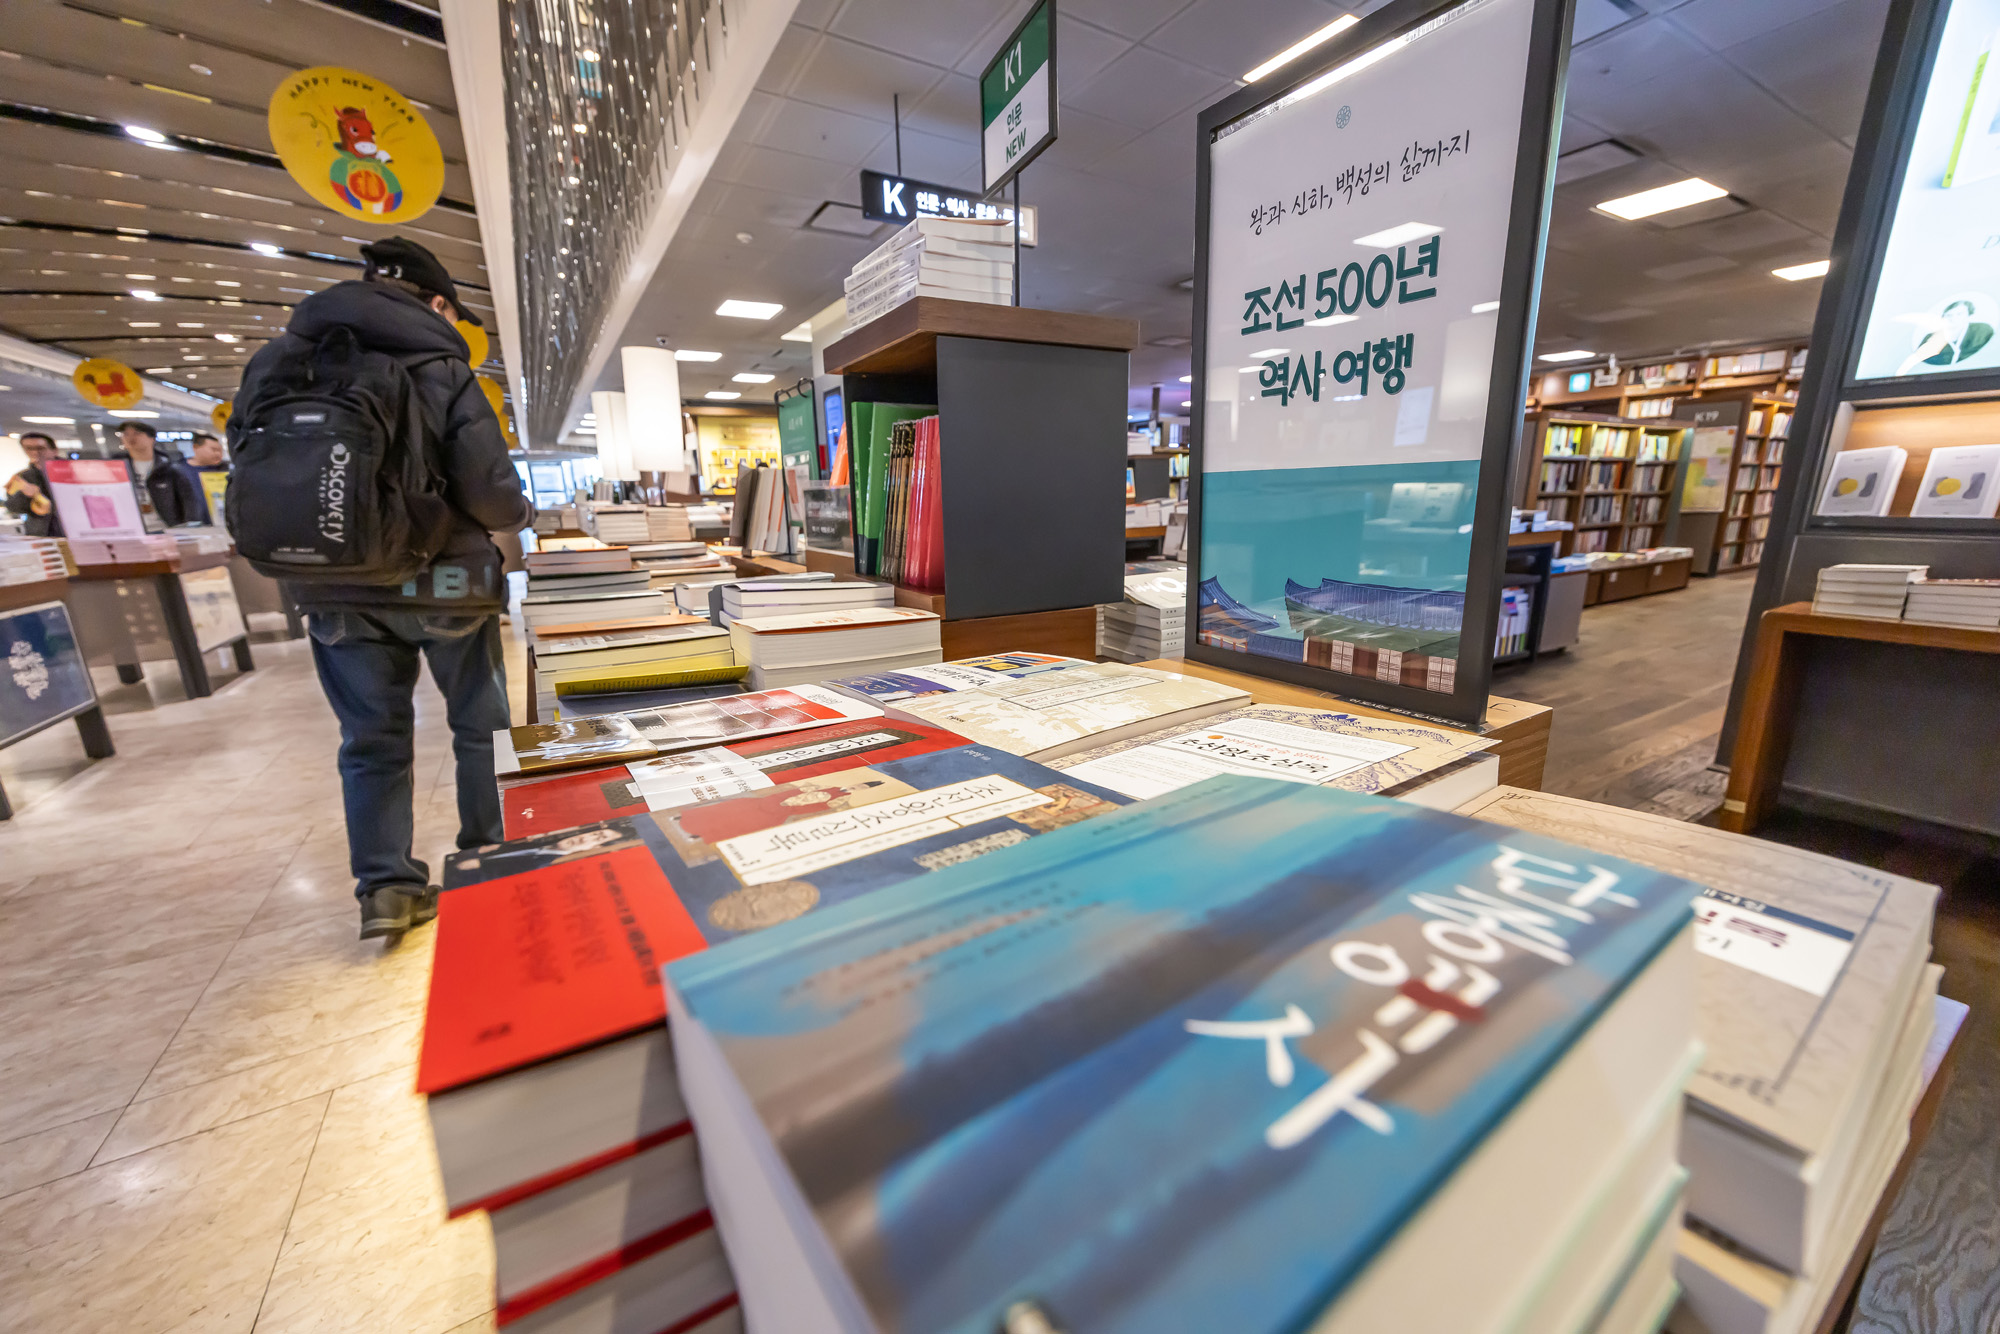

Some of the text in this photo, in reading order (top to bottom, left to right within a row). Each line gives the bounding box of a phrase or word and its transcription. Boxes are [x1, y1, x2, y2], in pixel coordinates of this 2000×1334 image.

[289, 77, 330, 99] HAPPY
[342, 77, 374, 92] NEW
[1004, 41, 1022, 92] K1
[1006, 101, 1023, 135] 인문
[1006, 127, 1027, 163] NEW
[882, 179, 907, 217] K
[1249, 129, 1471, 236] 왕과 신하, 백성의 삶까지
[1240, 235, 1441, 336] 조선 500년
[1258, 333, 1415, 407] 역사 여행
[322, 448, 351, 544] DISCOVERY
[1172, 737, 1329, 774] 조선왕조실록
[764, 783, 1004, 852] 조선왕조실록
[1184, 844, 1640, 1151] 단종애사
